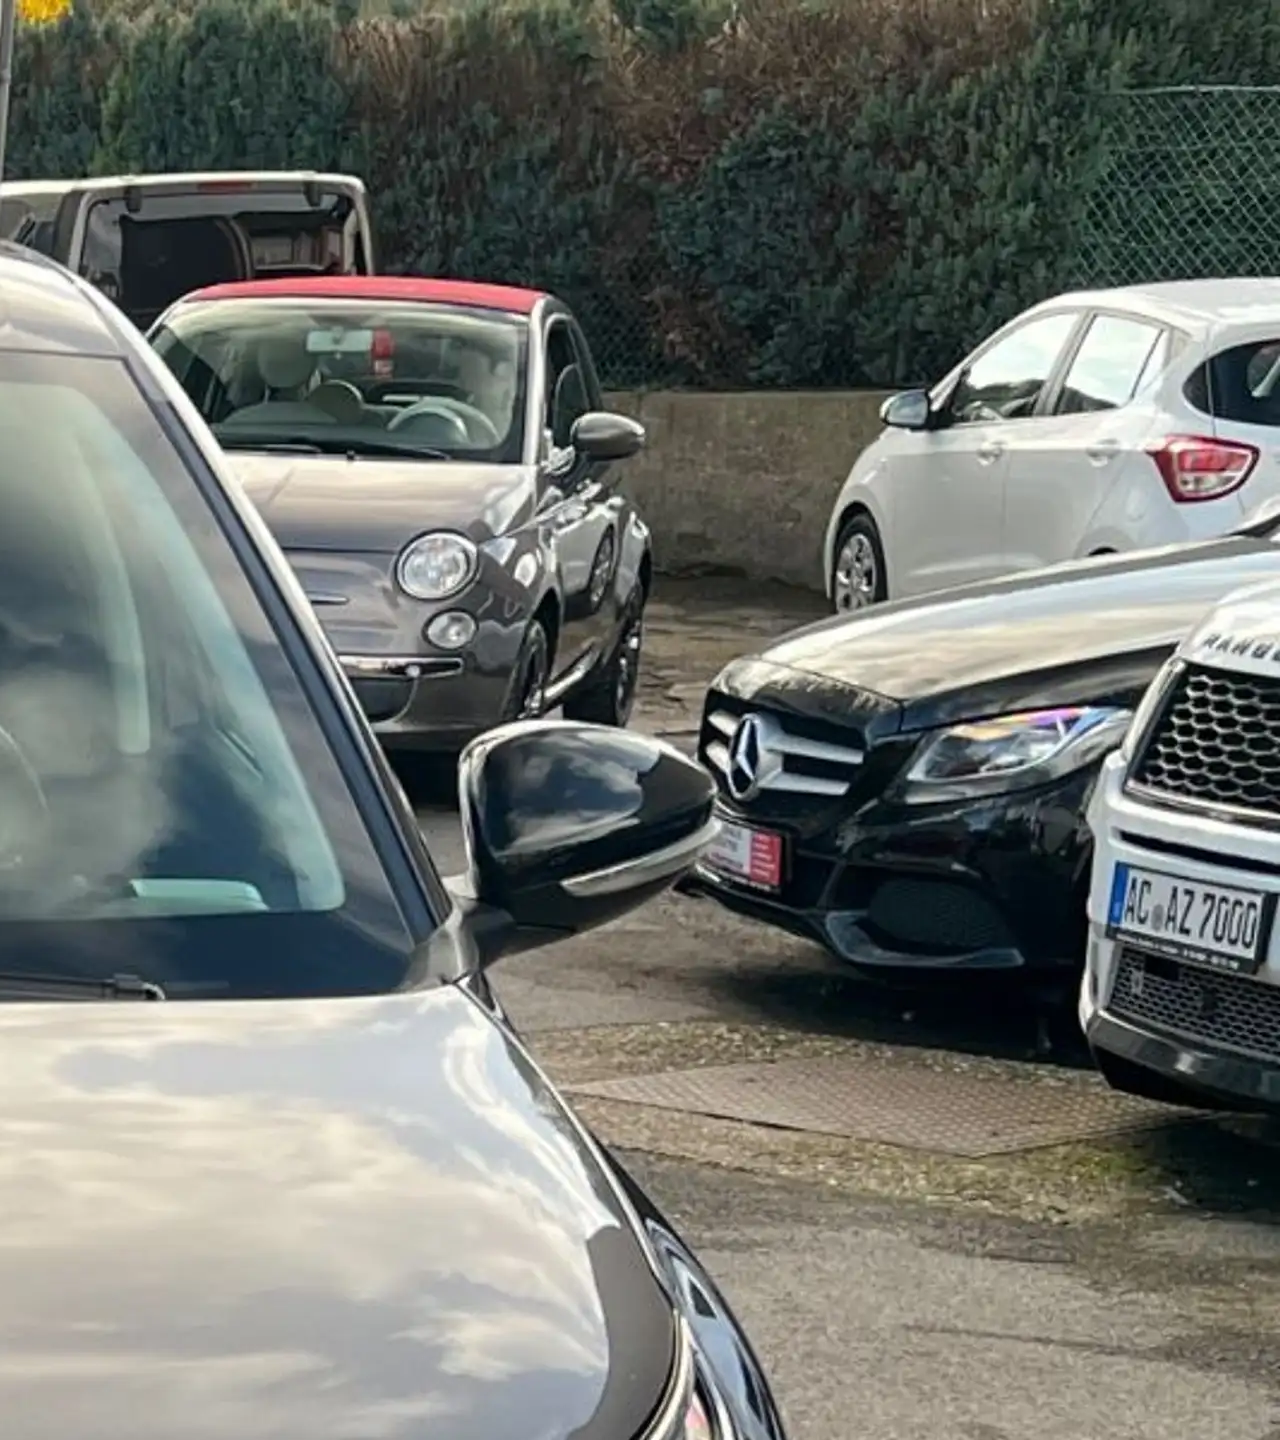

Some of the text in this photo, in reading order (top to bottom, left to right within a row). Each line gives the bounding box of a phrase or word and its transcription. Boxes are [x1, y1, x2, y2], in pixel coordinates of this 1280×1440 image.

[1125, 876, 1257, 949] AC AZ 7000
